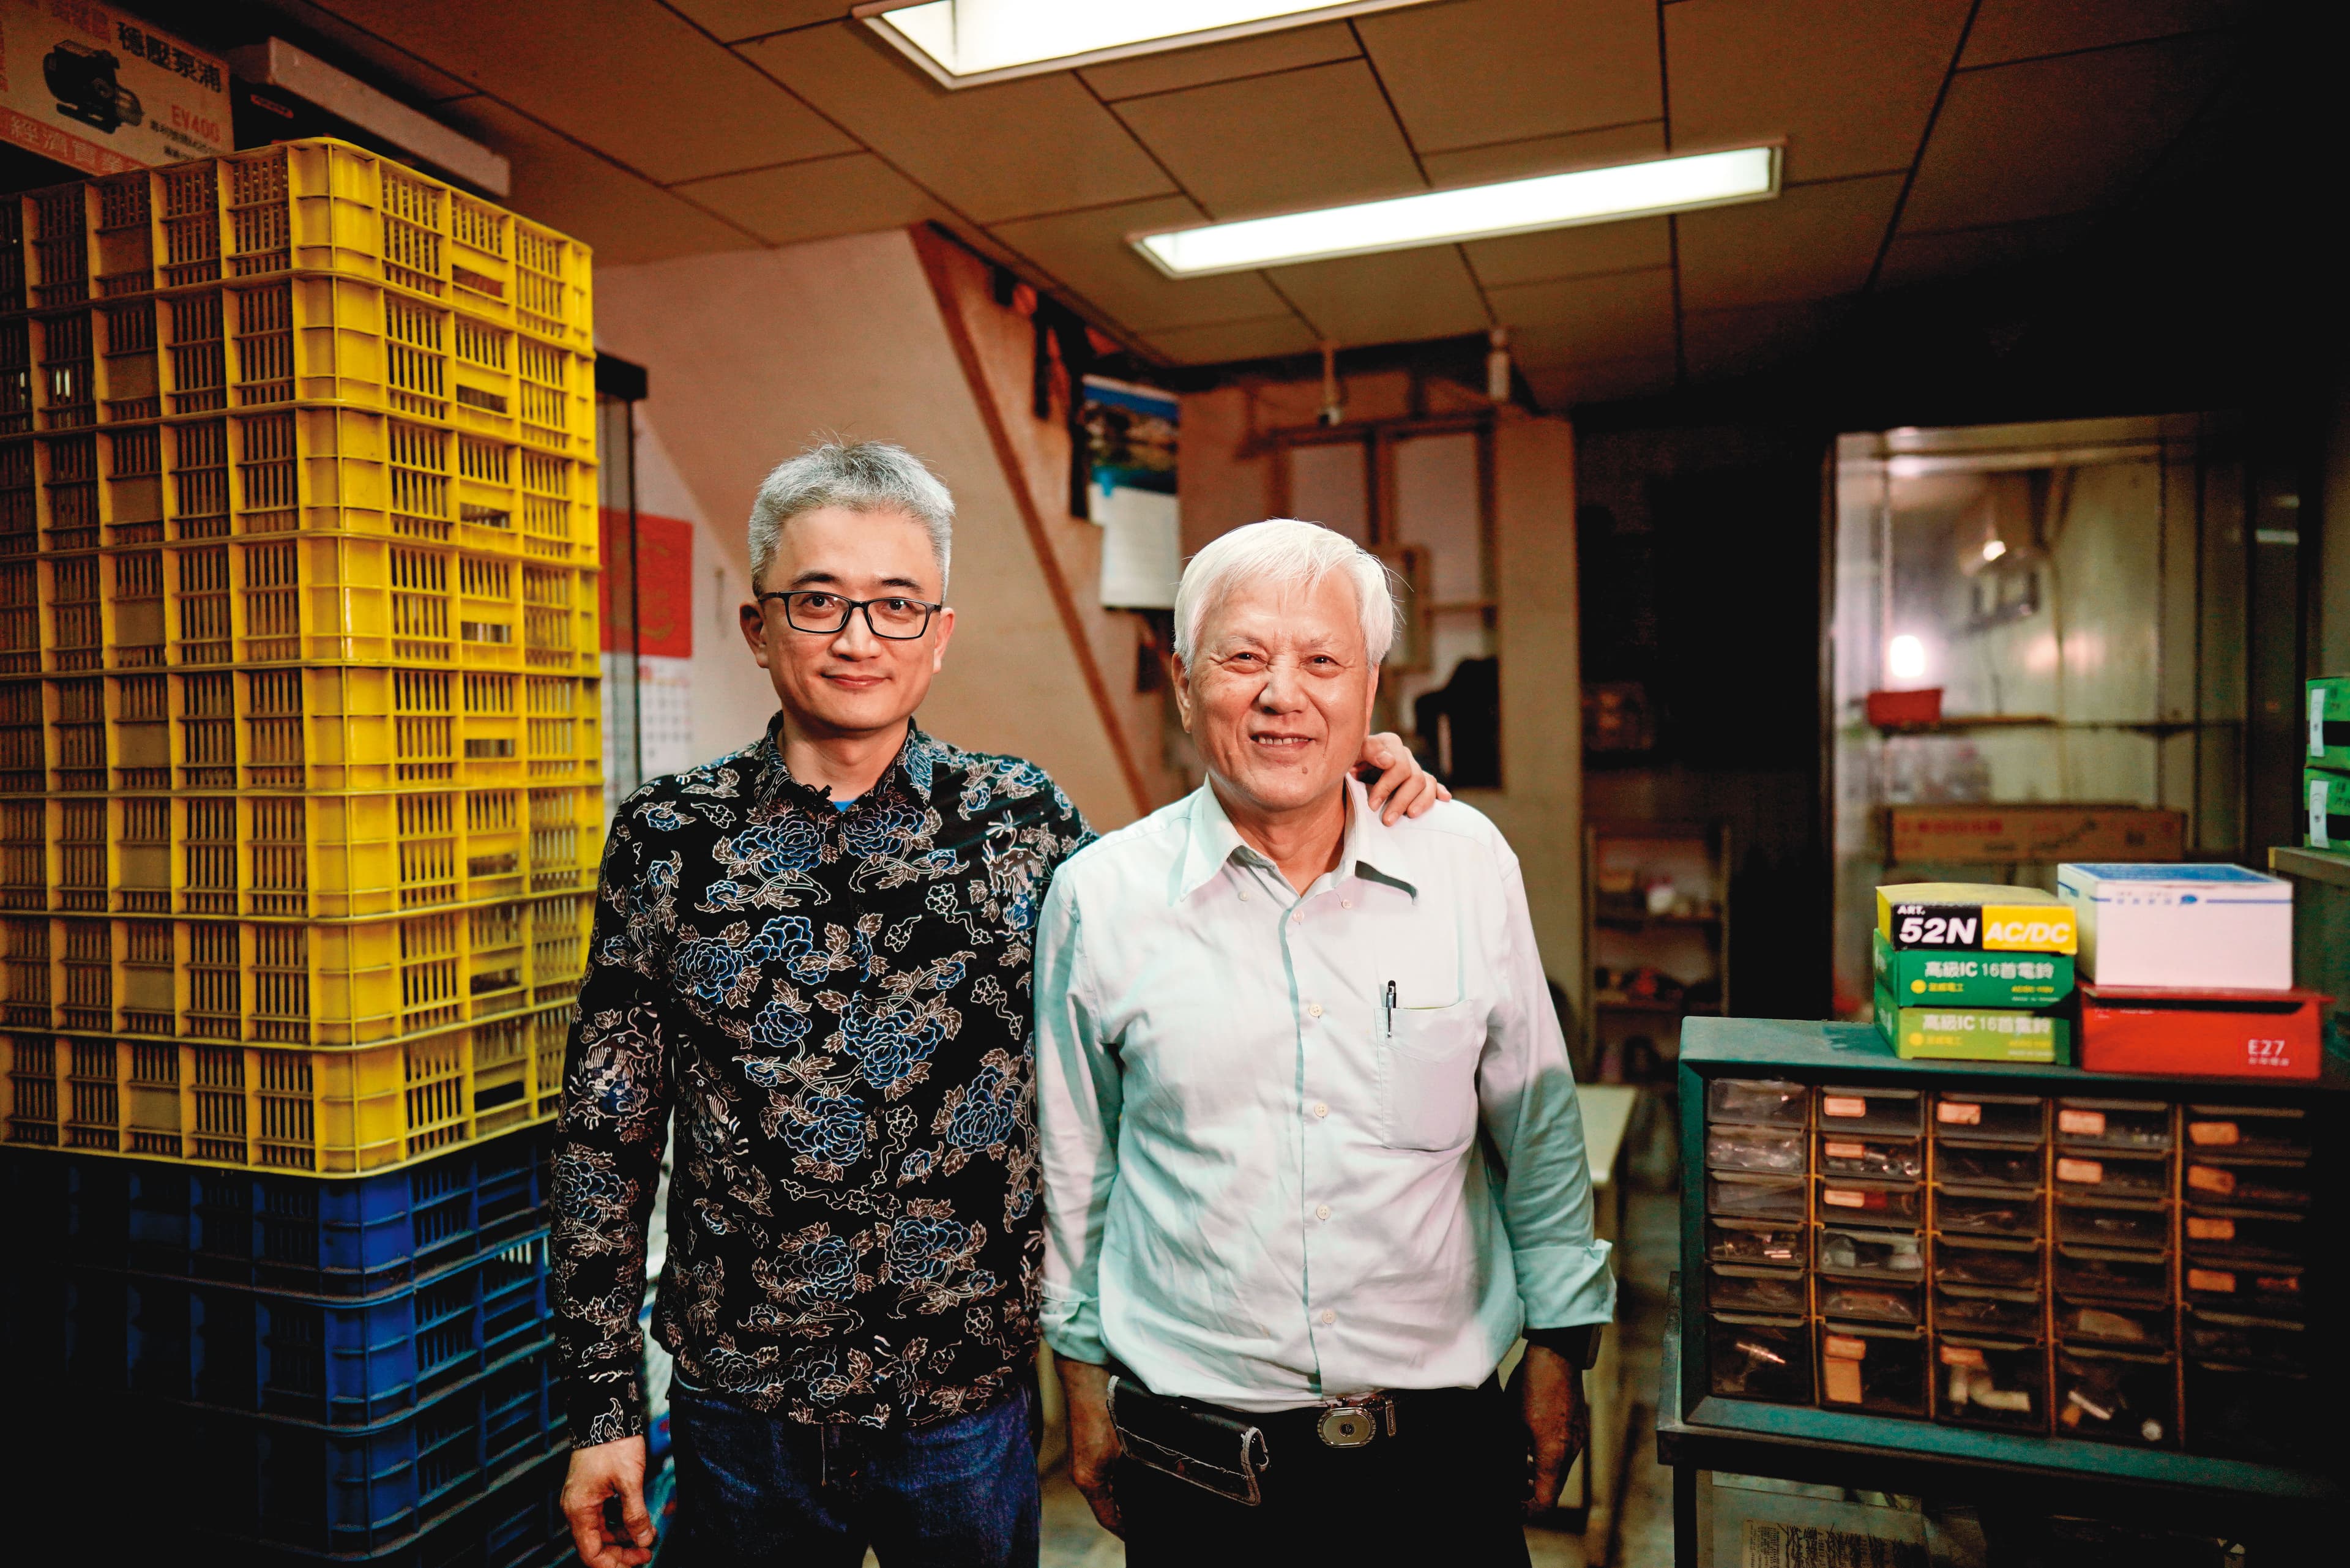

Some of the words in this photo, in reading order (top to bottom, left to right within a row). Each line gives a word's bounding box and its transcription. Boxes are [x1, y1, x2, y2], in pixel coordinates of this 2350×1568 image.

[1897, 905, 1926, 916] ART.
[1899, 917, 1977, 944] 52N
[1985, 922, 2072, 943] AC/DC
[2247, 1039, 2286, 1057] E27
